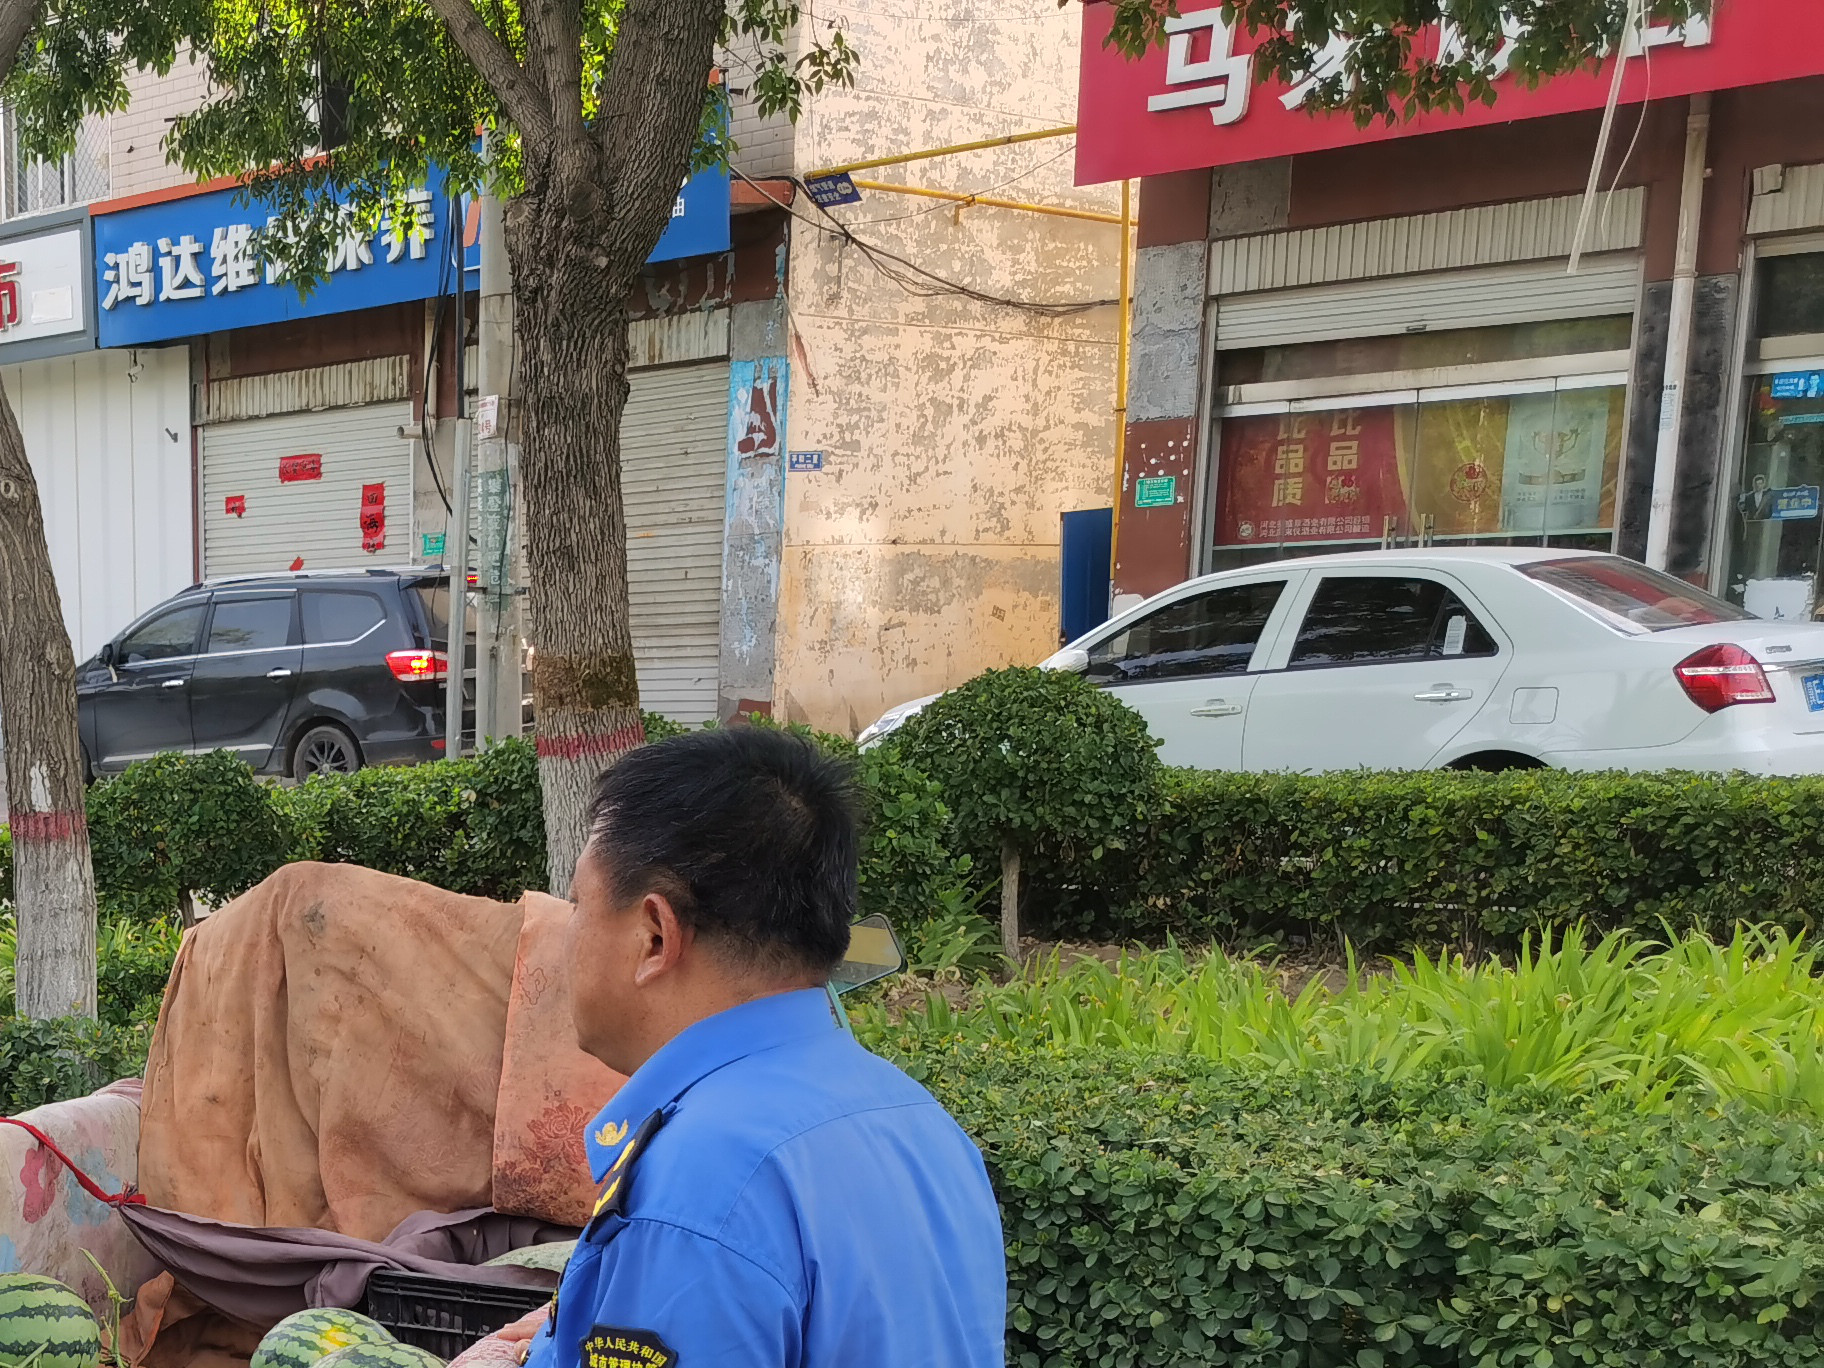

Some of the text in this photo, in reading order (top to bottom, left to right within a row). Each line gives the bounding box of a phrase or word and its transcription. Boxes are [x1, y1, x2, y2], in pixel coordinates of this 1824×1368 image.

[585, 1336, 667, 1368] 中华人民共和国
